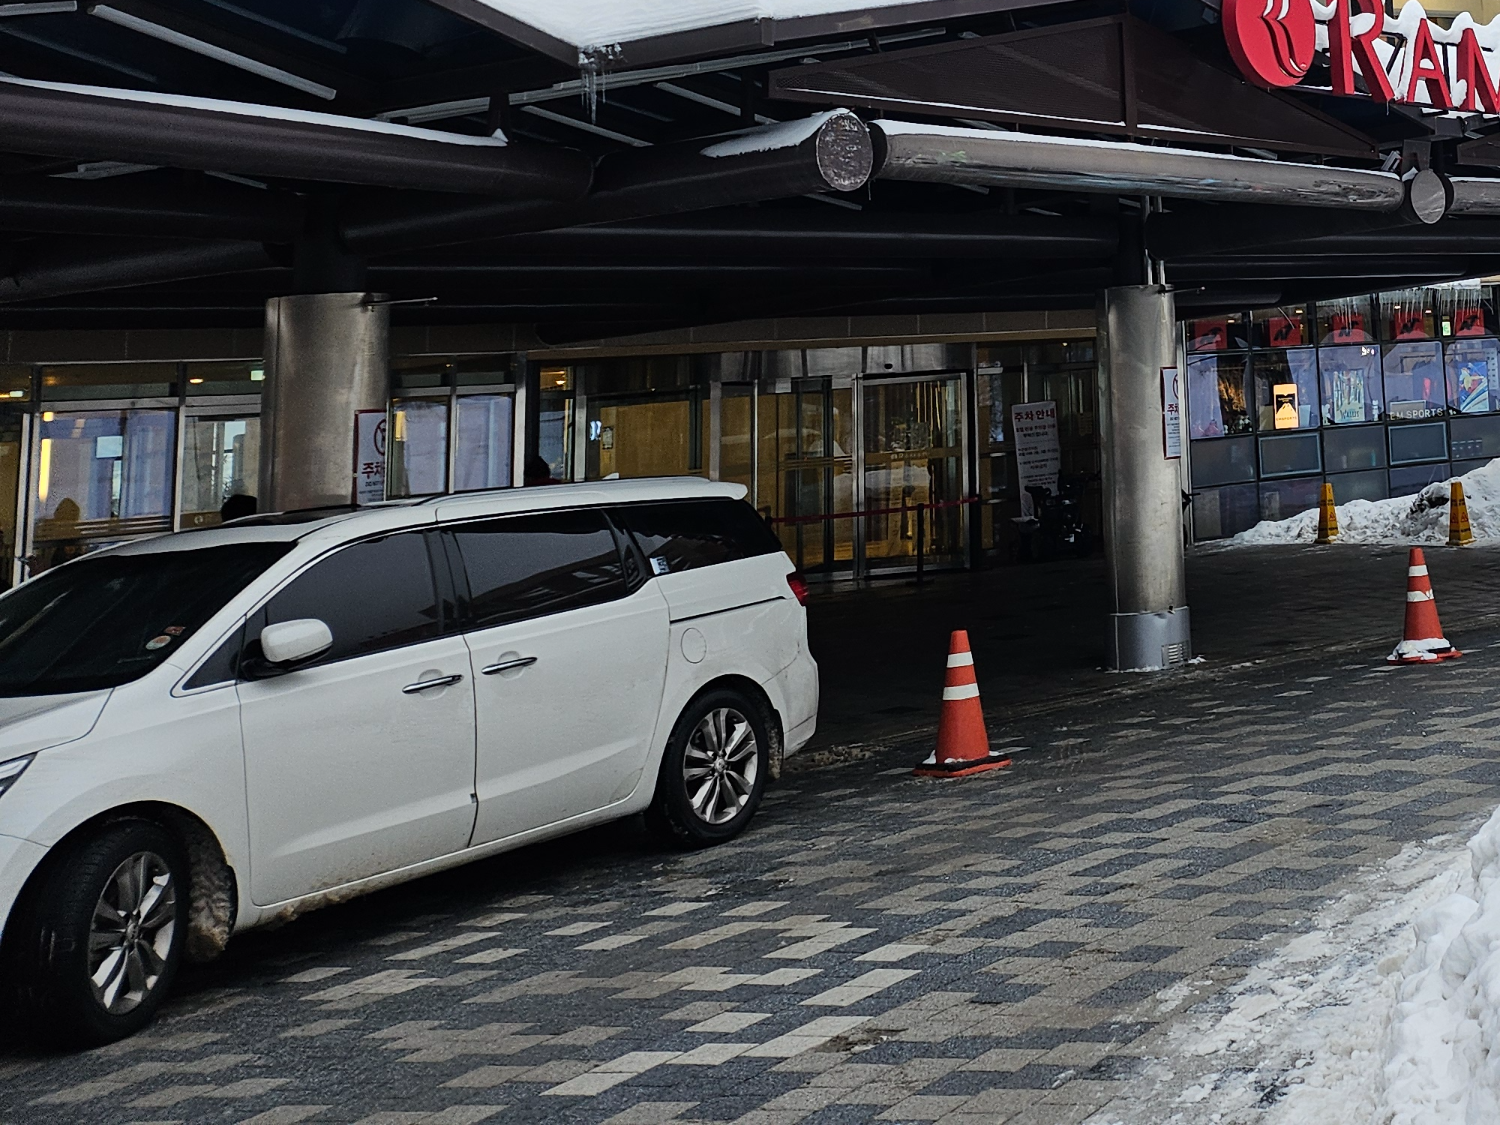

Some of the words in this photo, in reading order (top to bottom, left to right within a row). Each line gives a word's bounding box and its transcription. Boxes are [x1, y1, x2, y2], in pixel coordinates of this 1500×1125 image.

[1014, 410, 1034, 422] 주차
[1036, 408, 1055, 420] 안내
[1406, 408, 1443, 420] SPORTS
